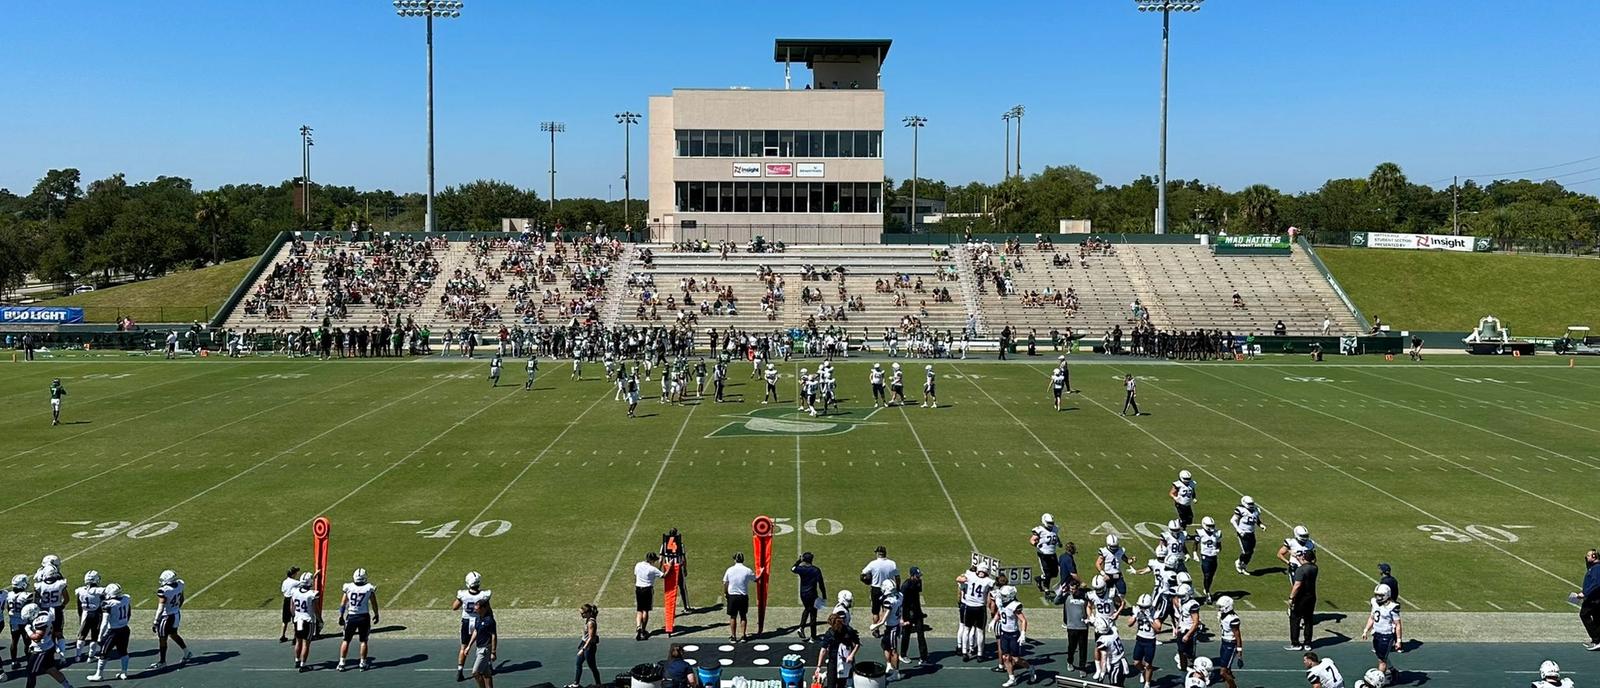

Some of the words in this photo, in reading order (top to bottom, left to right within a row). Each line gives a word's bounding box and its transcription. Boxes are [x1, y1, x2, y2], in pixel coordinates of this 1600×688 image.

[1225, 236, 1244, 244] MAD
[1246, 236, 1281, 244] HATTERS
[1431, 237, 1466, 248] Insight
[4, 311, 29, 320] BUD
[30, 311, 67, 320] LIGHT
[71, 521, 179, 538] 30
[415, 520, 512, 538] 40
[1416, 524, 1518, 543] 30
[667, 537, 677, 553] 4
[41, 590, 59, 603] 35
[971, 583, 983, 597] 14
[294, 599, 308, 613] 24
[350, 592, 366, 607] 97
[118, 604, 127, 620] 11
[1096, 603, 1111, 614] 20
[1325, 666, 1338, 683] 7
